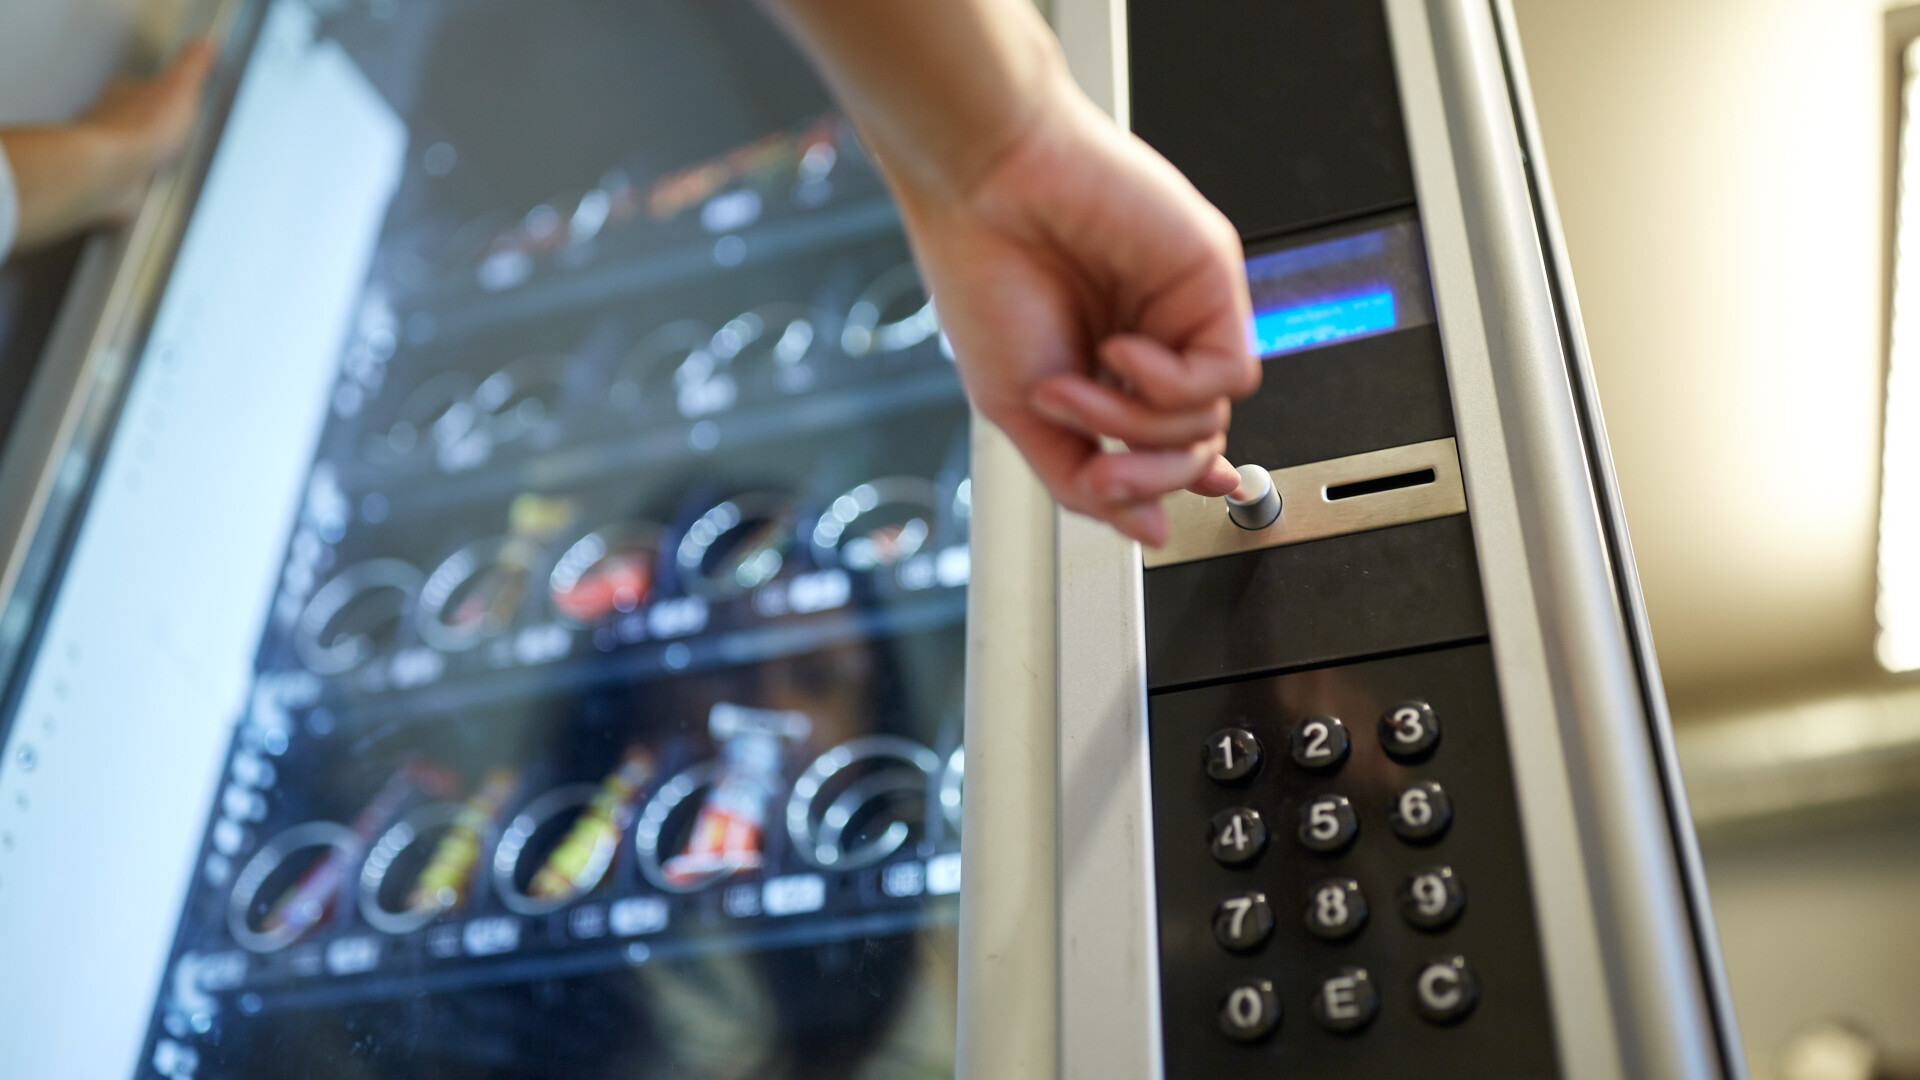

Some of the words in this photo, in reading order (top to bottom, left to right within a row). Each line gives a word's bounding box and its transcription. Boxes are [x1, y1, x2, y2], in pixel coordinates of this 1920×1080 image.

[1303, 722, 1331, 758] 2
[1393, 707, 1424, 743] 3
[1218, 735, 1234, 770] 1
[1310, 801, 1340, 840] 5
[1400, 788, 1432, 826] 6
[1219, 814, 1249, 851] 4
[1317, 885, 1349, 926] 8
[1412, 874, 1447, 915] 9
[1224, 897, 1253, 938] 7
[1324, 976, 1360, 1019] E
[1417, 963, 1462, 1010] C
